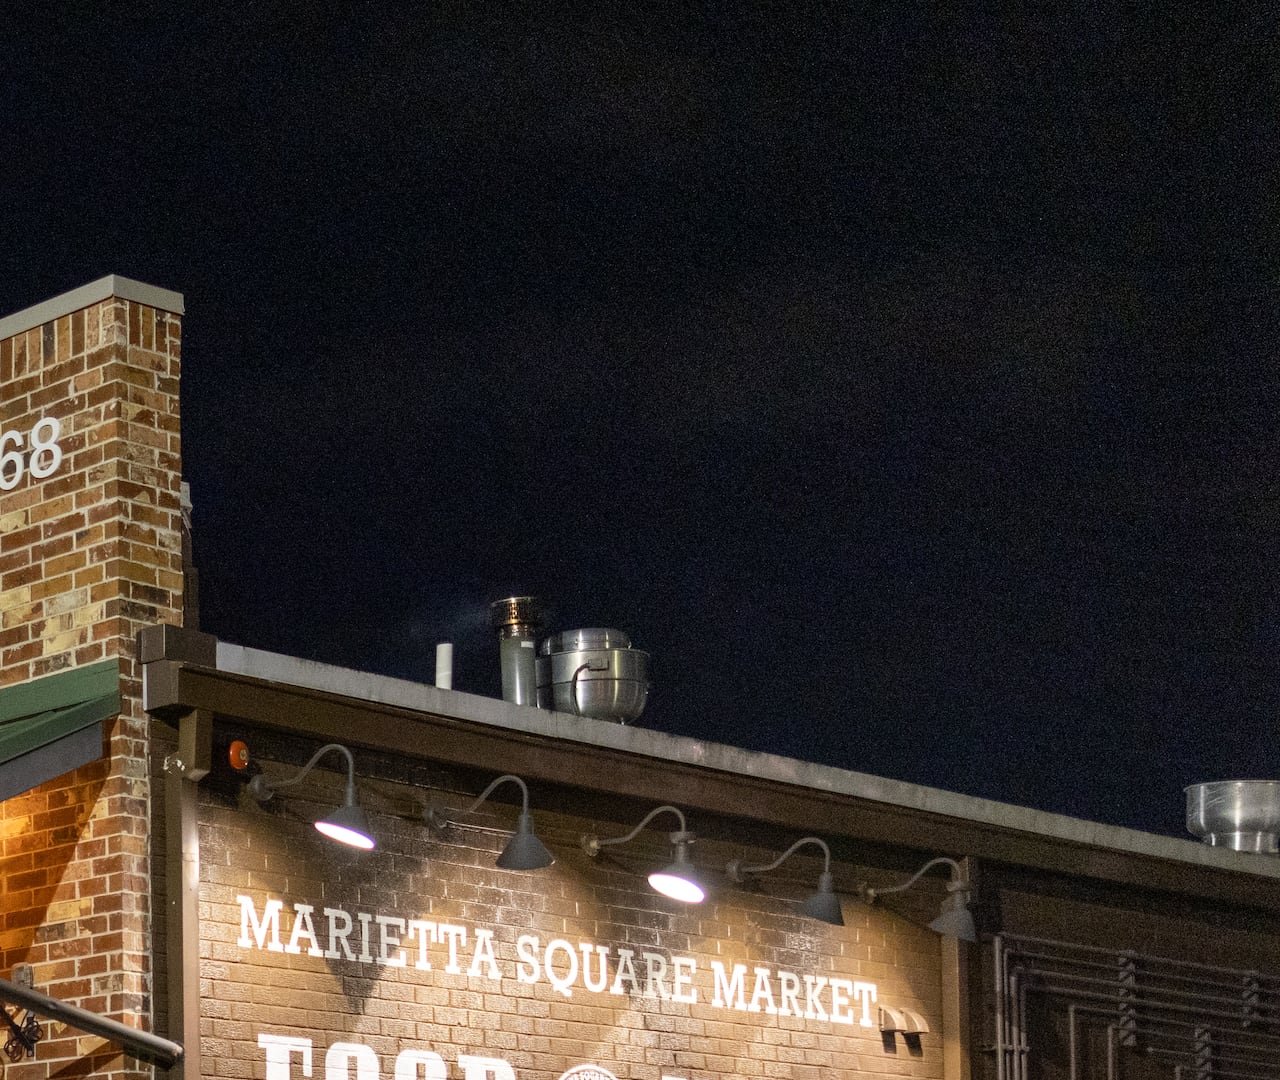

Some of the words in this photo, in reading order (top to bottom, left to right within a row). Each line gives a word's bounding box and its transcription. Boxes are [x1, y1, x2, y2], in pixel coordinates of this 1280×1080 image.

[237, 896, 502, 980] MARIETTA
[517, 934, 698, 1005] SQUARE
[711, 960, 878, 1028] MARKET
